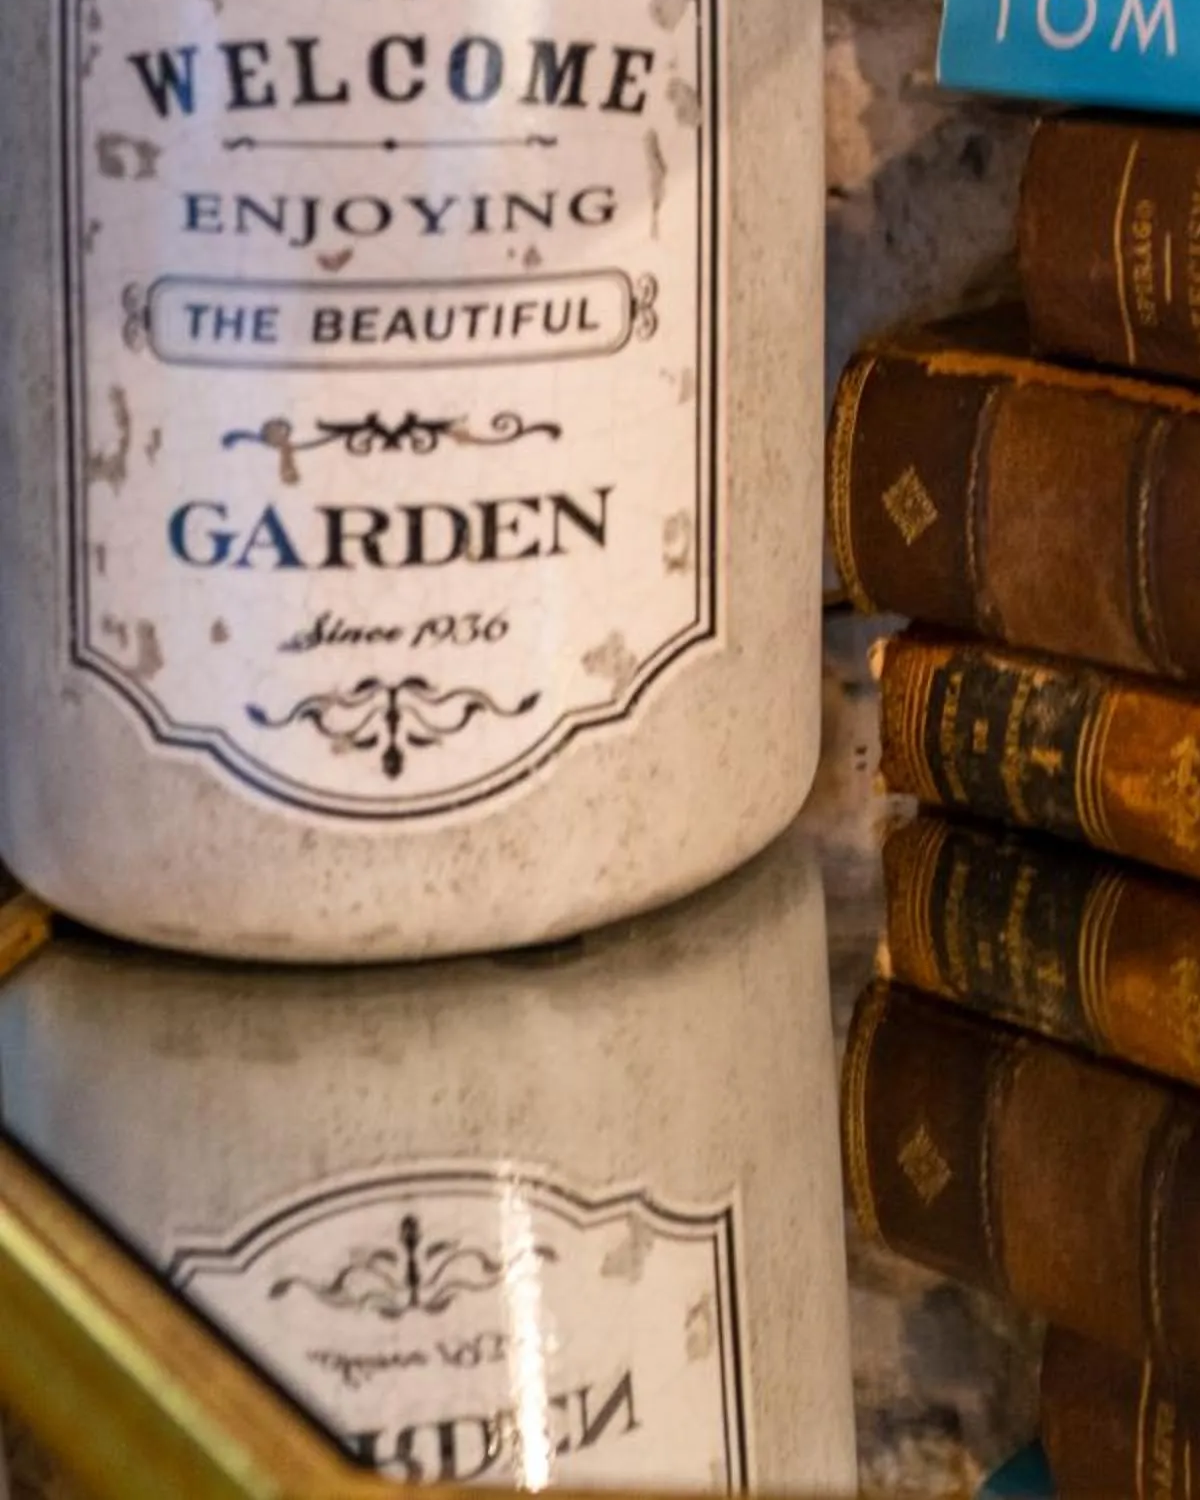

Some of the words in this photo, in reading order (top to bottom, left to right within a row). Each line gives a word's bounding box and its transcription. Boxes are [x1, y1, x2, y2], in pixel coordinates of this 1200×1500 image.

[126, 34, 656, 117] WELCOME
[179, 186, 619, 248] ENJOYING
[182, 303, 280, 343] THE
[311, 296, 600, 344] BEAUTIFUL
[166, 484, 614, 571] GARDEN
[277, 609, 403, 653] Since
[411, 611, 511, 652] 1936
